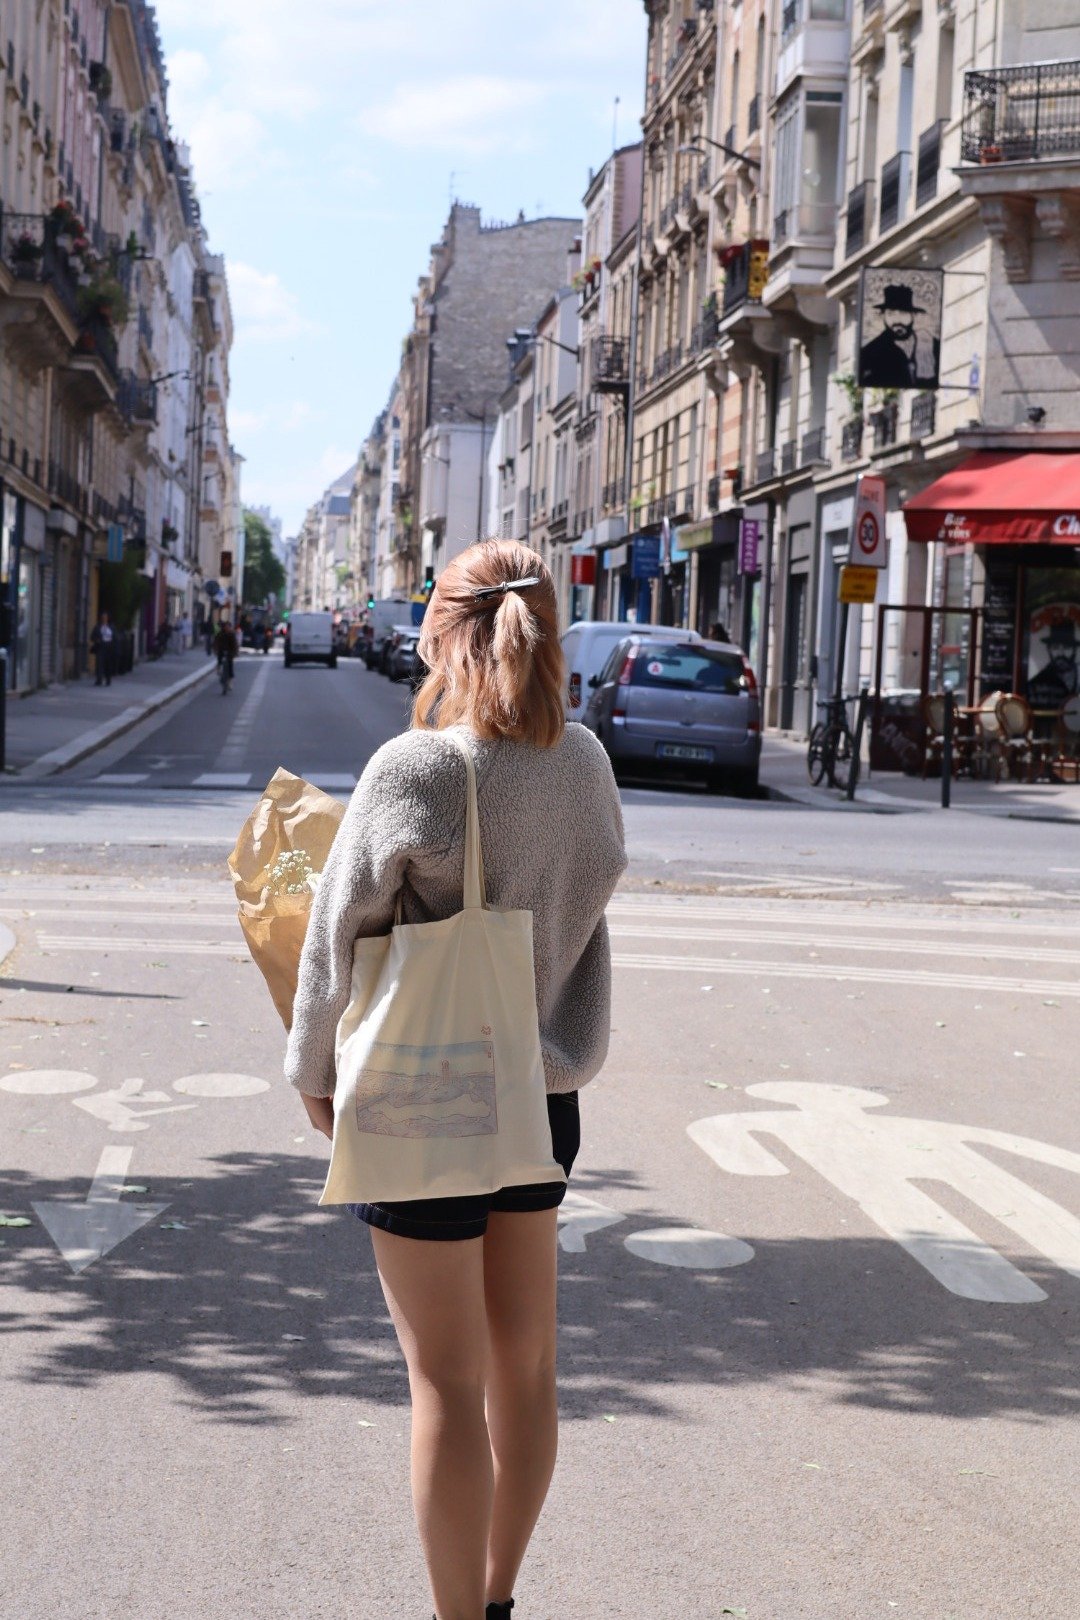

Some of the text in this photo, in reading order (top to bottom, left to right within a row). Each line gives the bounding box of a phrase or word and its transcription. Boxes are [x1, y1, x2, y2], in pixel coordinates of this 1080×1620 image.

[863, 522, 873, 542] 30
[1053, 514, 1080, 536] Ch
[744, 522, 756, 572] MASSAGE
